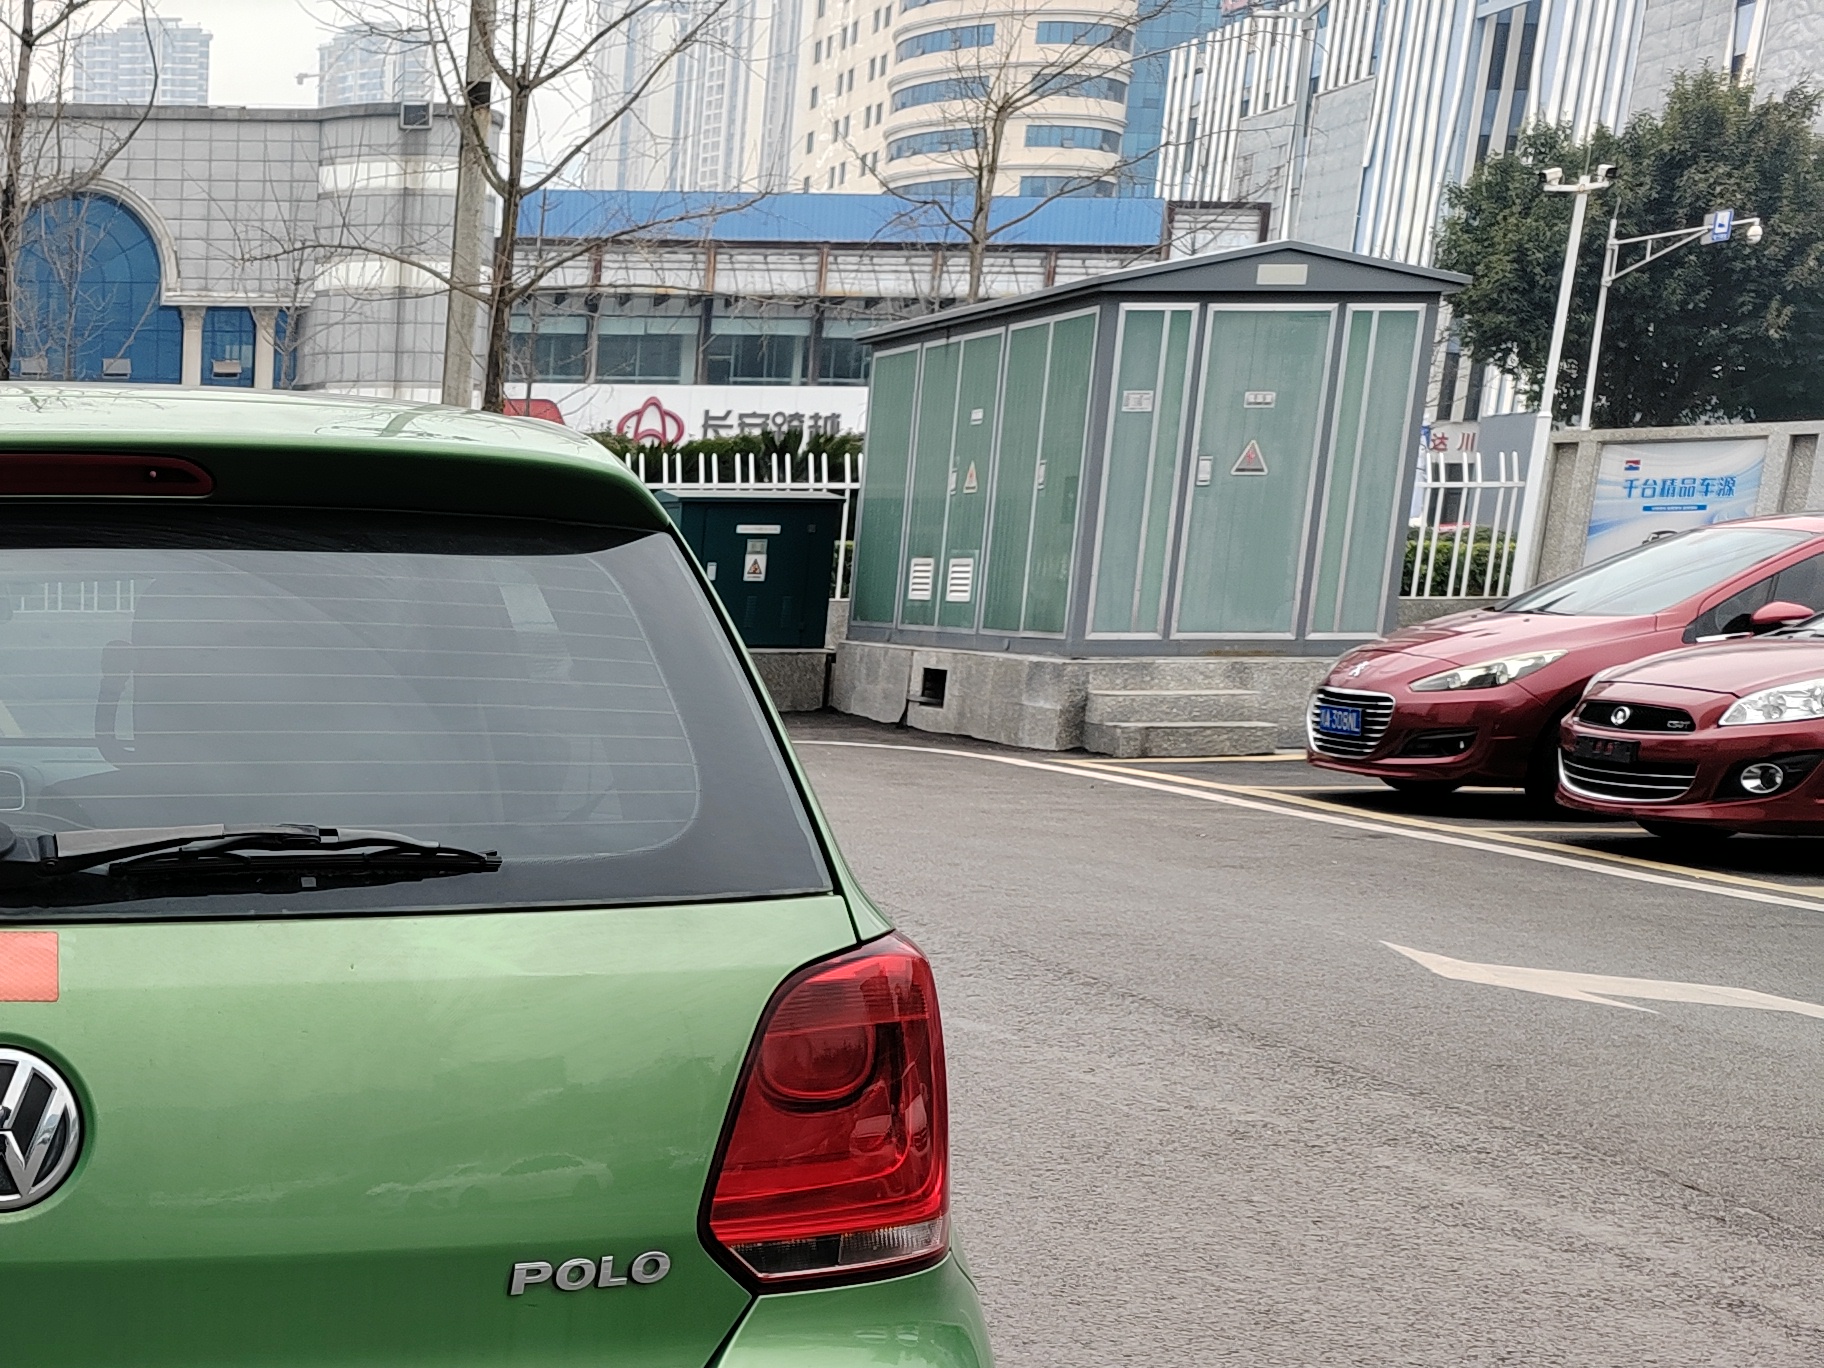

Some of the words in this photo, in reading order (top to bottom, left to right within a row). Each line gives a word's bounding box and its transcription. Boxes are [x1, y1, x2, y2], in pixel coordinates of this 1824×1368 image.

[1623, 476, 1736, 499] 千台精品车源
[508, 1250, 671, 1296] POLO
